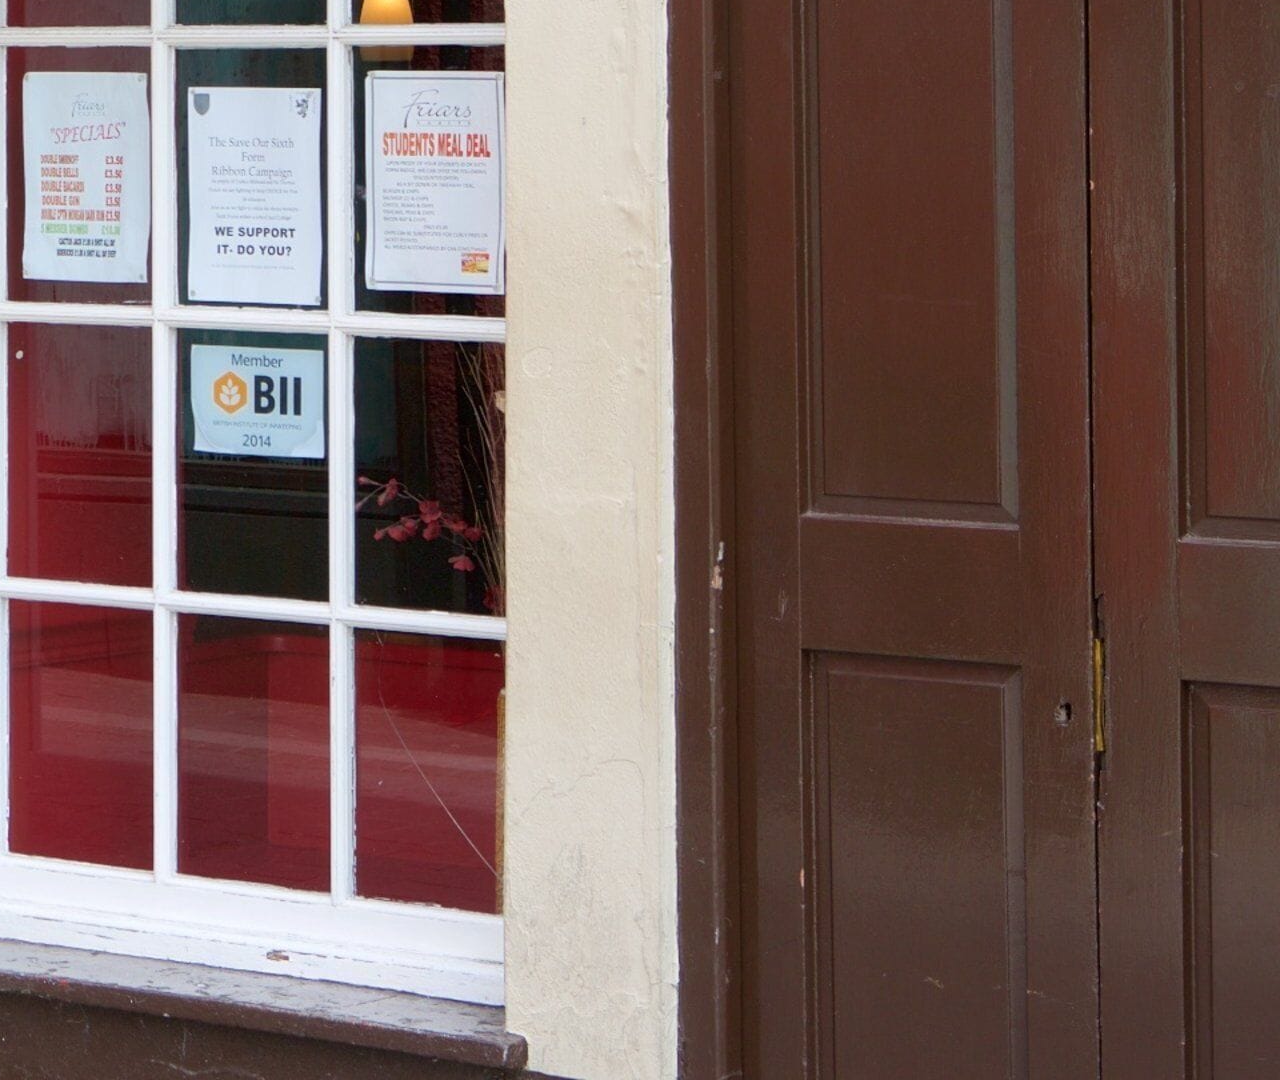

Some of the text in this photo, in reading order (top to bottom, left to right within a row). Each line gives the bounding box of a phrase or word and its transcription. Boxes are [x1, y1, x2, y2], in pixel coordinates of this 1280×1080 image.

[402, 88, 472, 128] Friars
[208, 136, 227, 148] The
[382, 132, 491, 158] STUDENTS MEAL DEAL
[211, 165, 246, 176] Ribbon
[214, 226, 296, 238] WE SUPPORT
[237, 245, 255, 255] DO
[259, 245, 292, 256] YOU?
[231, 353, 284, 368] Member
[254, 375, 302, 416] BII
[242, 434, 272, 447] 2014
